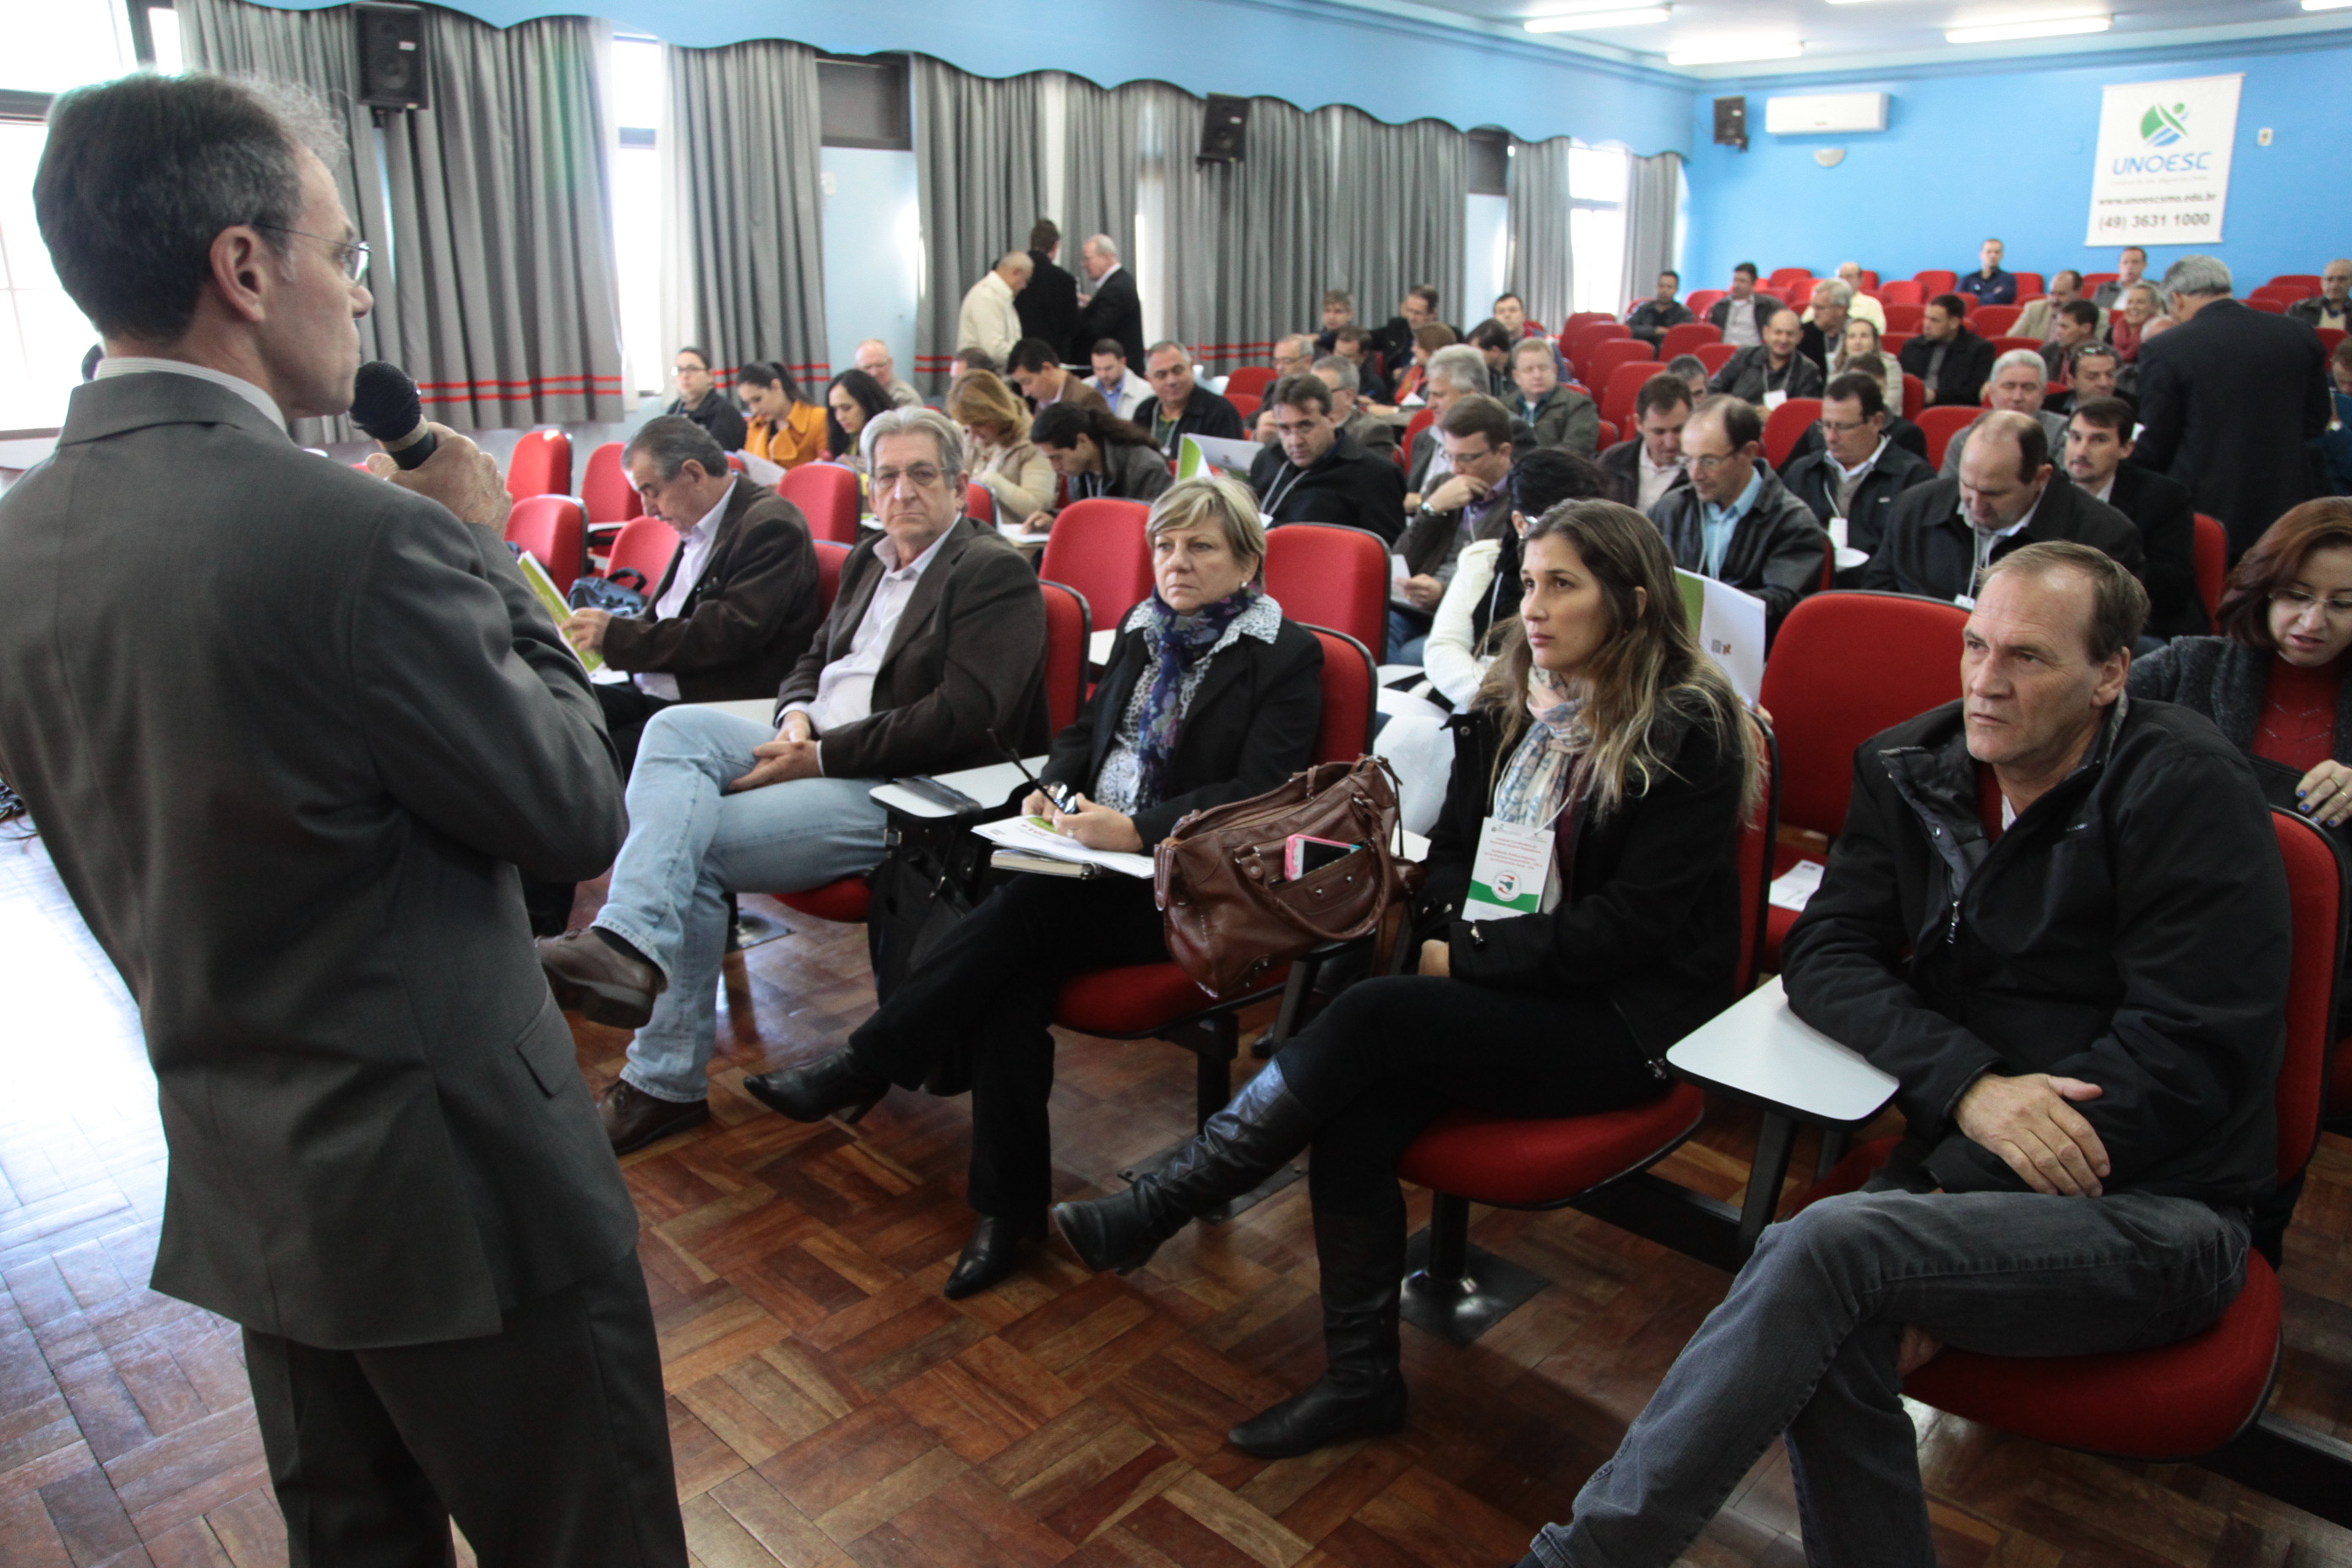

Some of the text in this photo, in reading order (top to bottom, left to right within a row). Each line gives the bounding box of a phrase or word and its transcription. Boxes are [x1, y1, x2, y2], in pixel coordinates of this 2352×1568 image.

[2112, 151, 2211, 175] UNOESC
[2099, 212, 2210, 231] (49) 3631 1000
